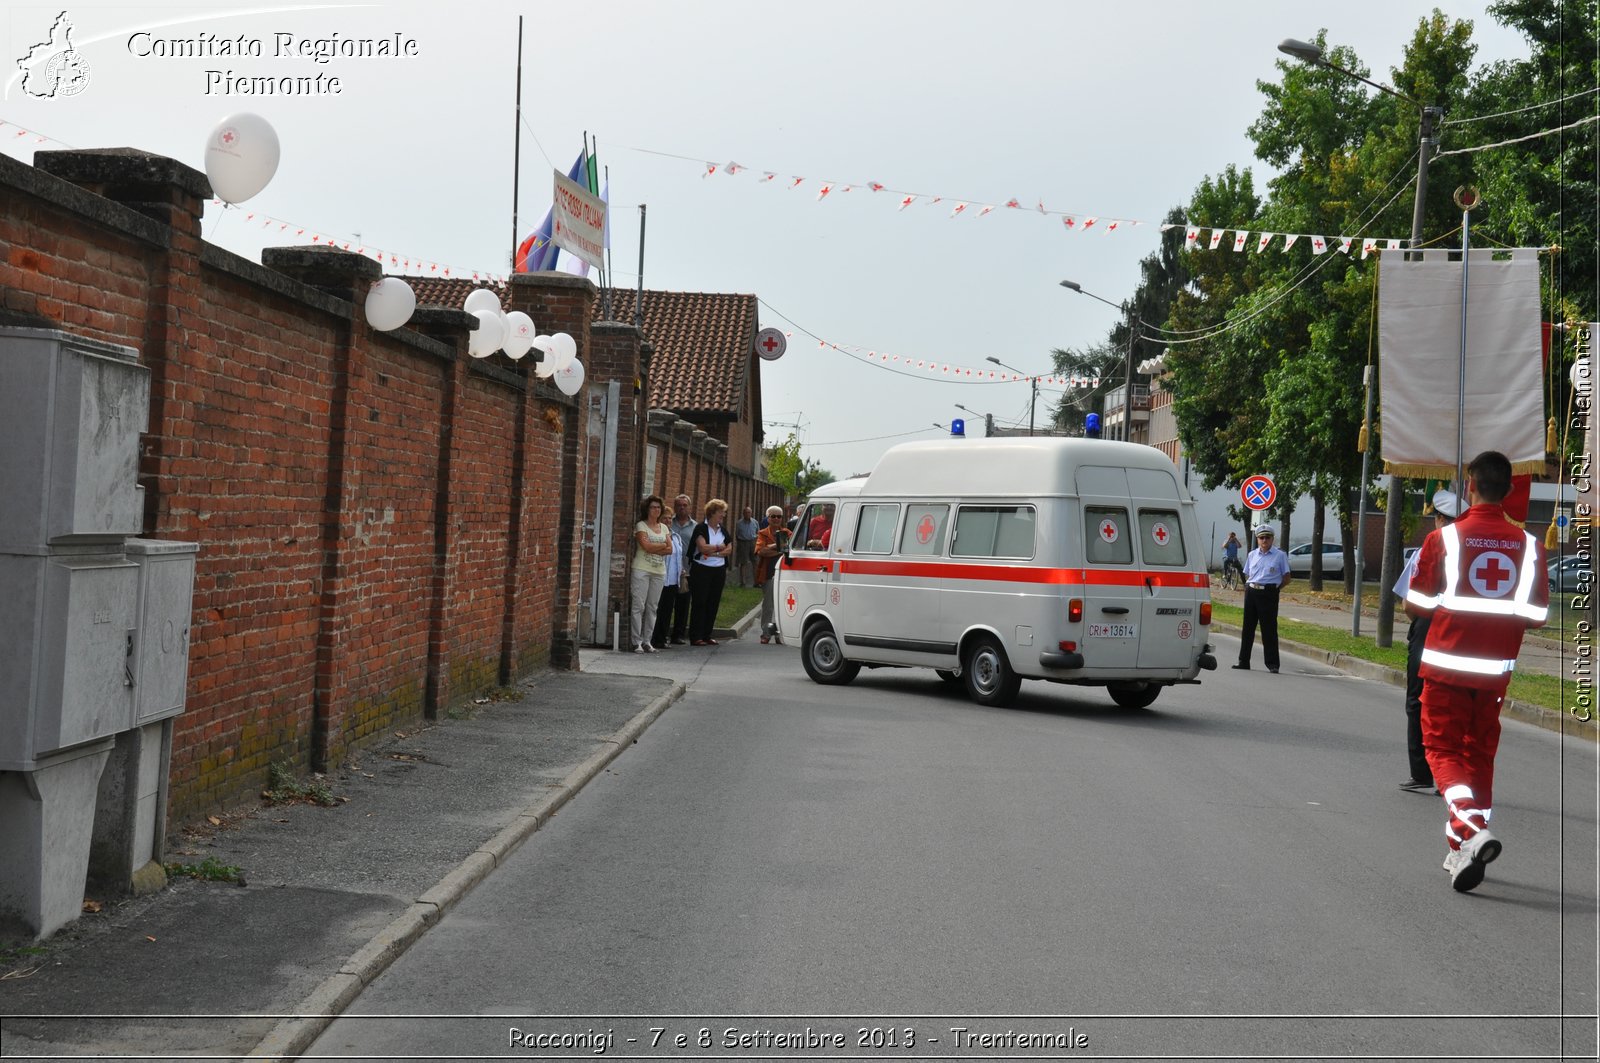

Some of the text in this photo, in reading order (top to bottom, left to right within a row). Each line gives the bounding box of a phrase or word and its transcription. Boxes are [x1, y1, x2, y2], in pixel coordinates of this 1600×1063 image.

[1465, 537, 1521, 550] CROCE ROSSA ITALIANA
[1089, 625, 1133, 637] CRI 13614
